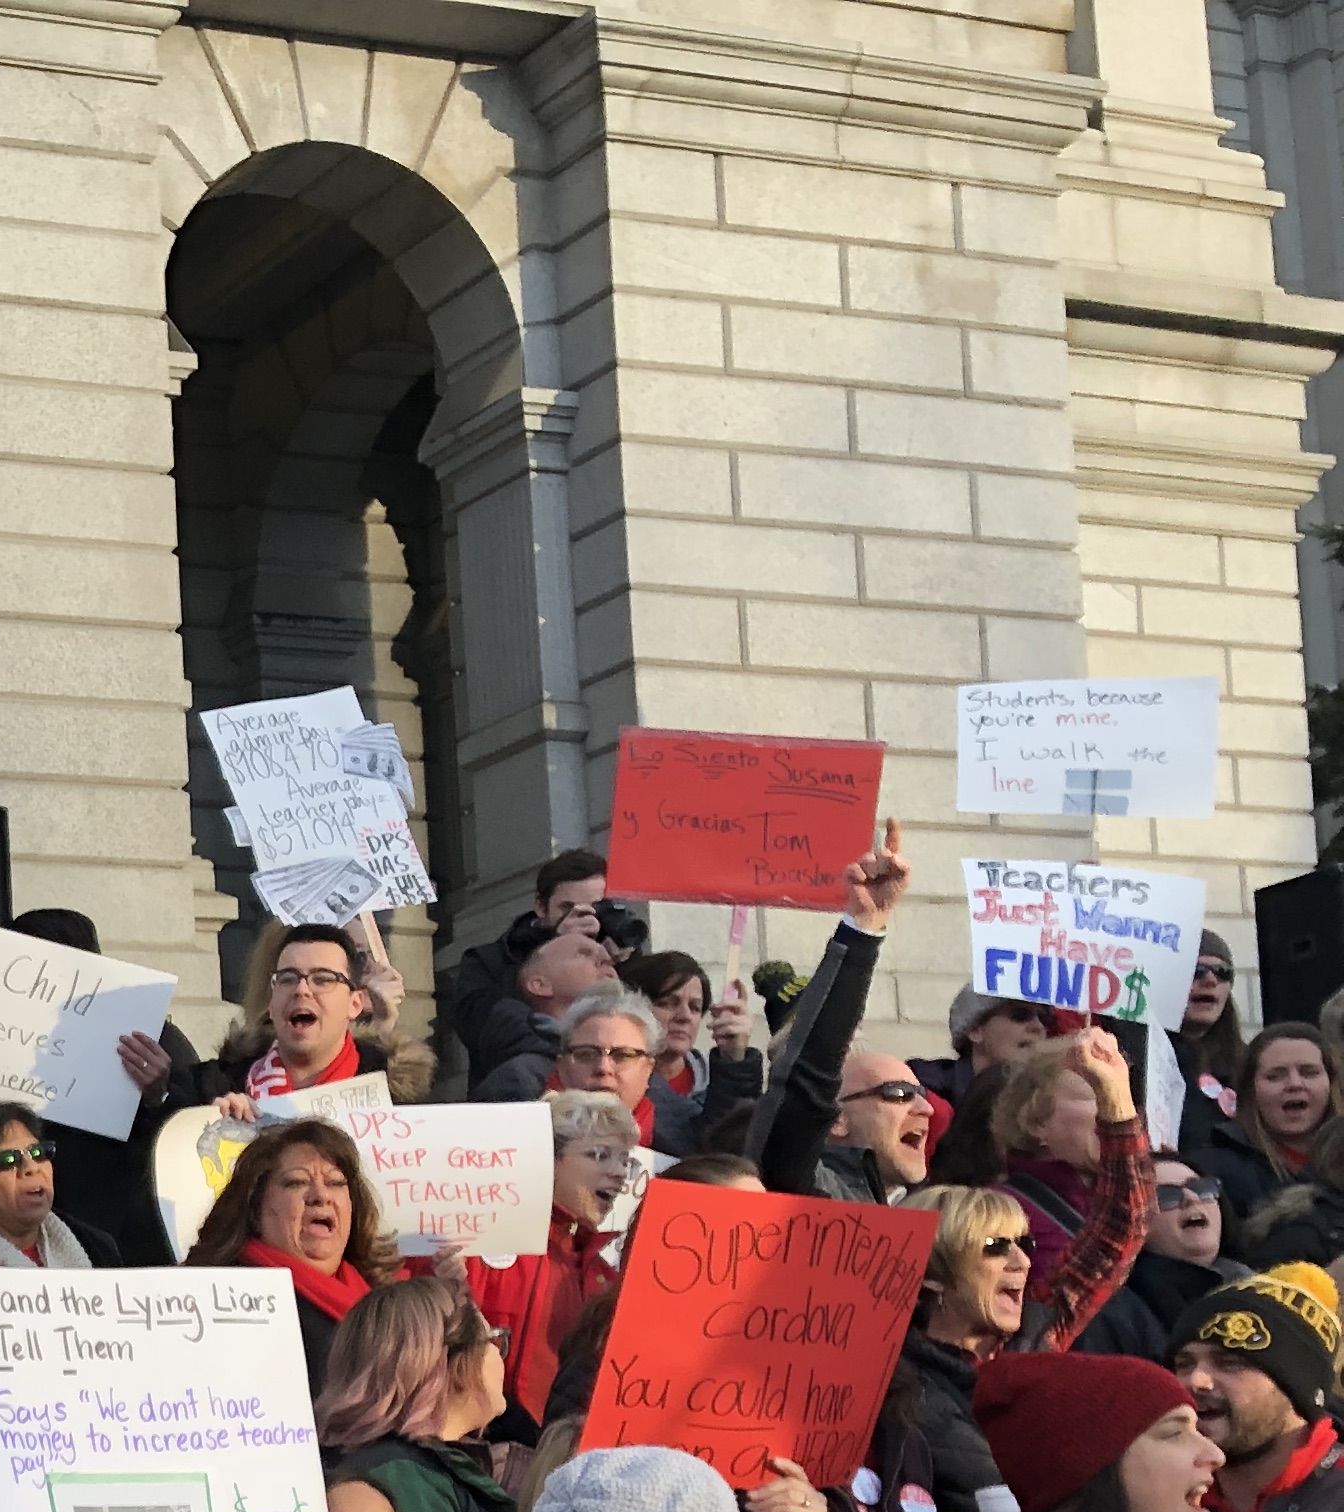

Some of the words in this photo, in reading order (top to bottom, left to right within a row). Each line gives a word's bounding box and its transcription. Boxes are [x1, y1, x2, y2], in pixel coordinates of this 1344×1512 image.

[1086, 688, 1165, 708] because
[216, 708, 302, 738] Average
[969, 713, 1037, 735] you're
[229, 729, 295, 752] admin
[628, 741, 663, 763] Lo
[673, 744, 760, 768] Siento
[975, 737, 999, 763] I
[1020, 740, 1105, 762] walk
[1127, 748, 1169, 766] the
[286, 775, 364, 801] Average
[991, 766, 1039, 794] line
[259, 798, 337, 827] teacher
[366, 831, 410, 854] DPS
[622, 809, 640, 840] y
[657, 800, 746, 835] Gracias
[746, 811, 813, 858] Tom
[368, 854, 410, 878] HAS
[977, 860, 1152, 905] Teachers
[972, 888, 1060, 926] Just
[1073, 897, 1182, 954] Wanna
[1040, 926, 1136, 972] Have
[2, 955, 103, 1018] Child
[984, 946, 1152, 1022] FUND$
[340, 1083, 382, 1109] THE
[371, 1144, 428, 1174] KEEP
[448, 1146, 519, 1170] GREAT
[387, 1179, 522, 1209] TEACHERS
[0, 1283, 51, 1316] and
[60, 1286, 104, 1317] the
[115, 1282, 204, 1342] Lying
[211, 1282, 277, 1316] Liars
[53, 1325, 134, 1363] Them
[139, 1388, 200, 1422] don't
[207, 1387, 266, 1421] have
[609, 1355, 670, 1409] You
[686, 1362, 792, 1424] could
[802, 1367, 854, 1426] have
[0, 1429, 77, 1465] money
[86, 1426, 112, 1453] to
[123, 1426, 230, 1453] increase
[238, 1421, 314, 1449] teacher
[730, 1444, 779, 1481] a
